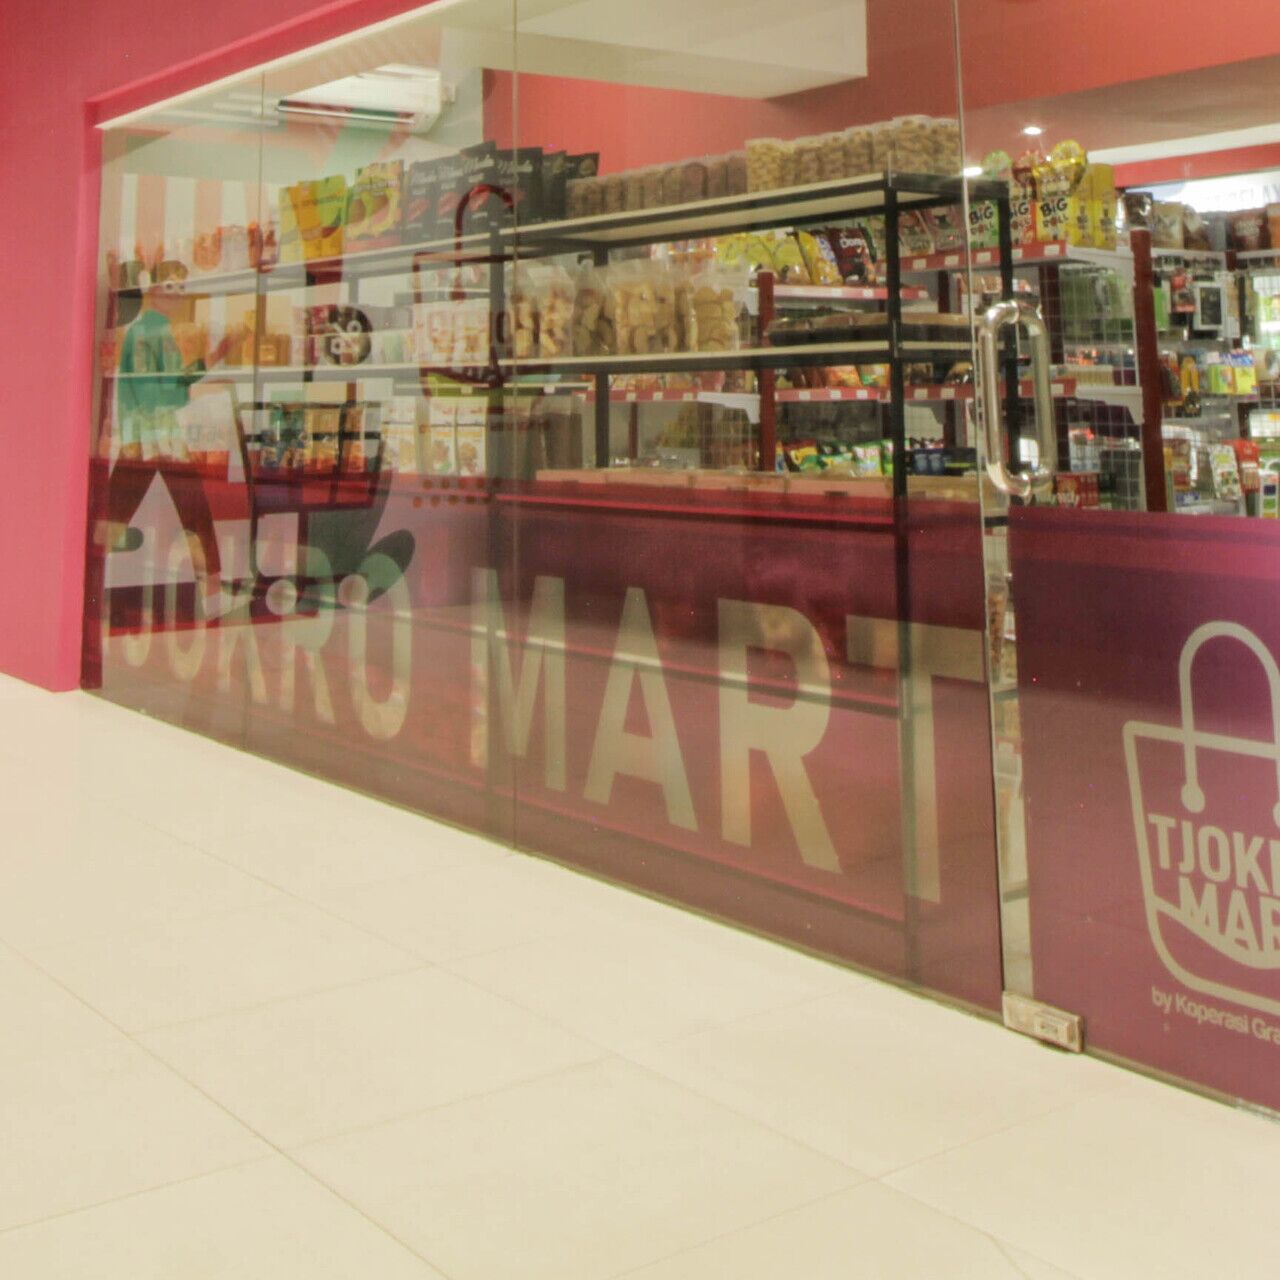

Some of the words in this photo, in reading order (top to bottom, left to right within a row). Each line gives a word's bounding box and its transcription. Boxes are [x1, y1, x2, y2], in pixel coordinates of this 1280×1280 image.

[470, 565, 986, 904] MART
[1151, 985, 1172, 1015] by
[1176, 992, 1249, 1035] Koperasi
